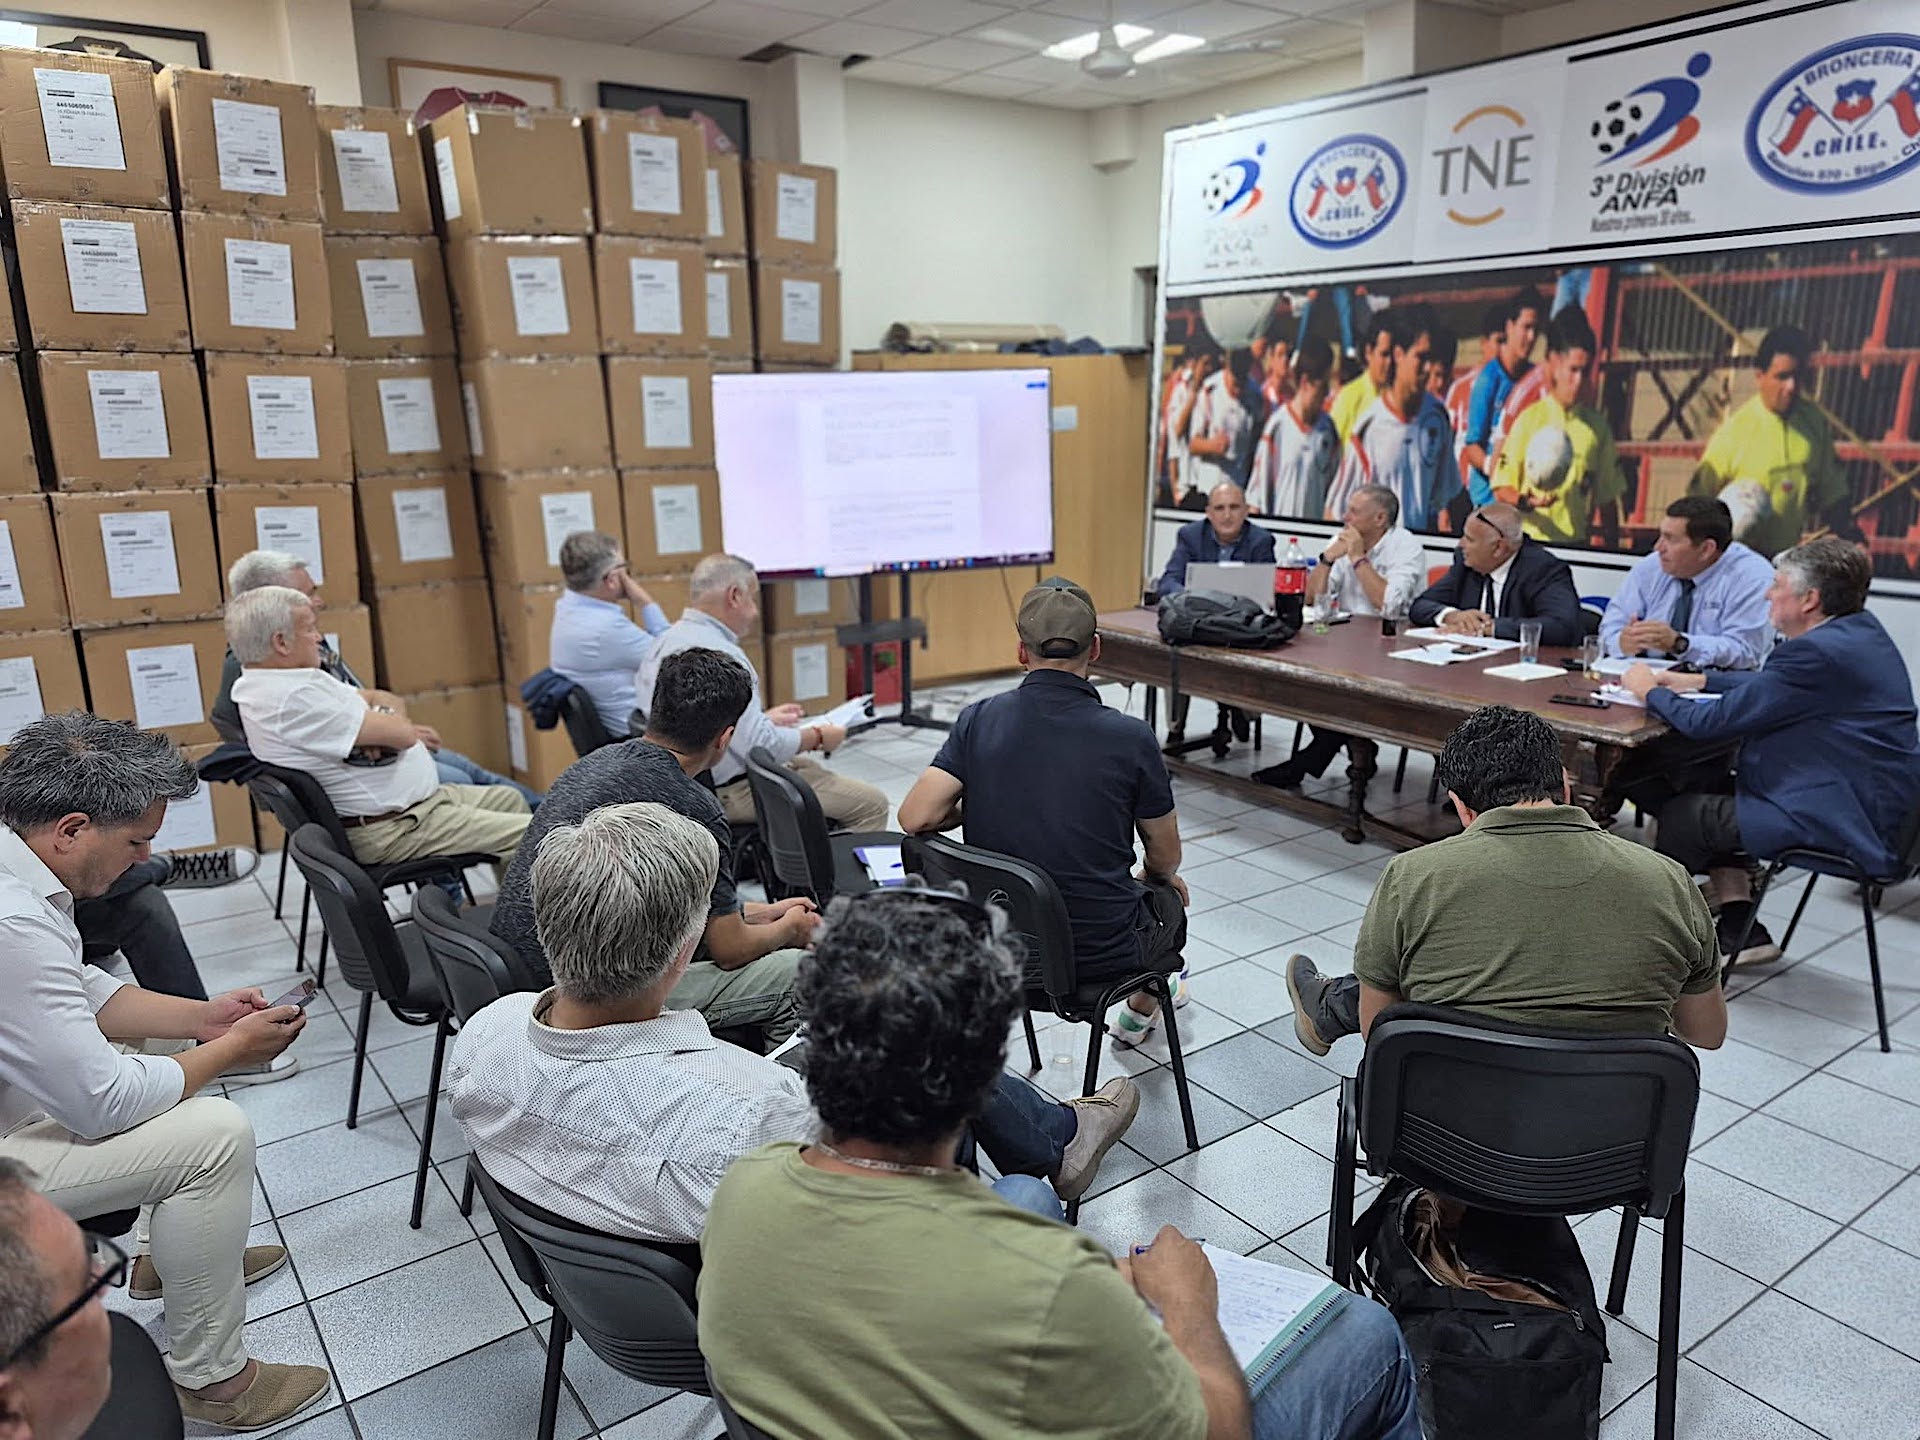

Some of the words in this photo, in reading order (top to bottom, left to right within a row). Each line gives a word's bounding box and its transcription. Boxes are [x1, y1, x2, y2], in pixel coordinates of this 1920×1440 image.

[1804, 50, 1914, 86] BRONCERIA
[1431, 133, 1536, 197] TNE
[1616, 163, 1706, 194] División
[1599, 186, 1678, 215] ANFA
